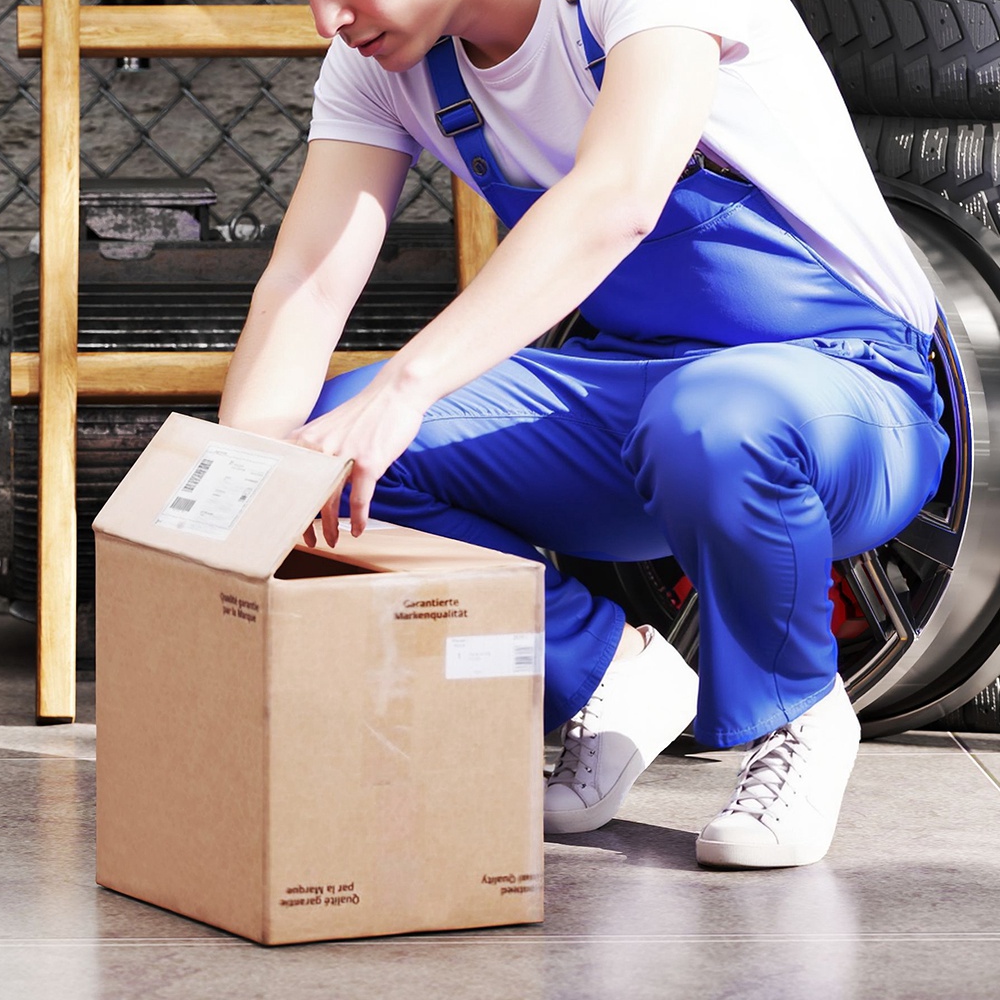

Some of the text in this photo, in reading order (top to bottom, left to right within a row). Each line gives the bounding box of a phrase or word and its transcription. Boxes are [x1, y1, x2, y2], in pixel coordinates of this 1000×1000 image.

[403, 598, 460, 608] Garantierte
[393, 610, 468, 621] Markenqualität
[338, 882, 354, 893] par
[324, 893, 360, 907] Qualité
